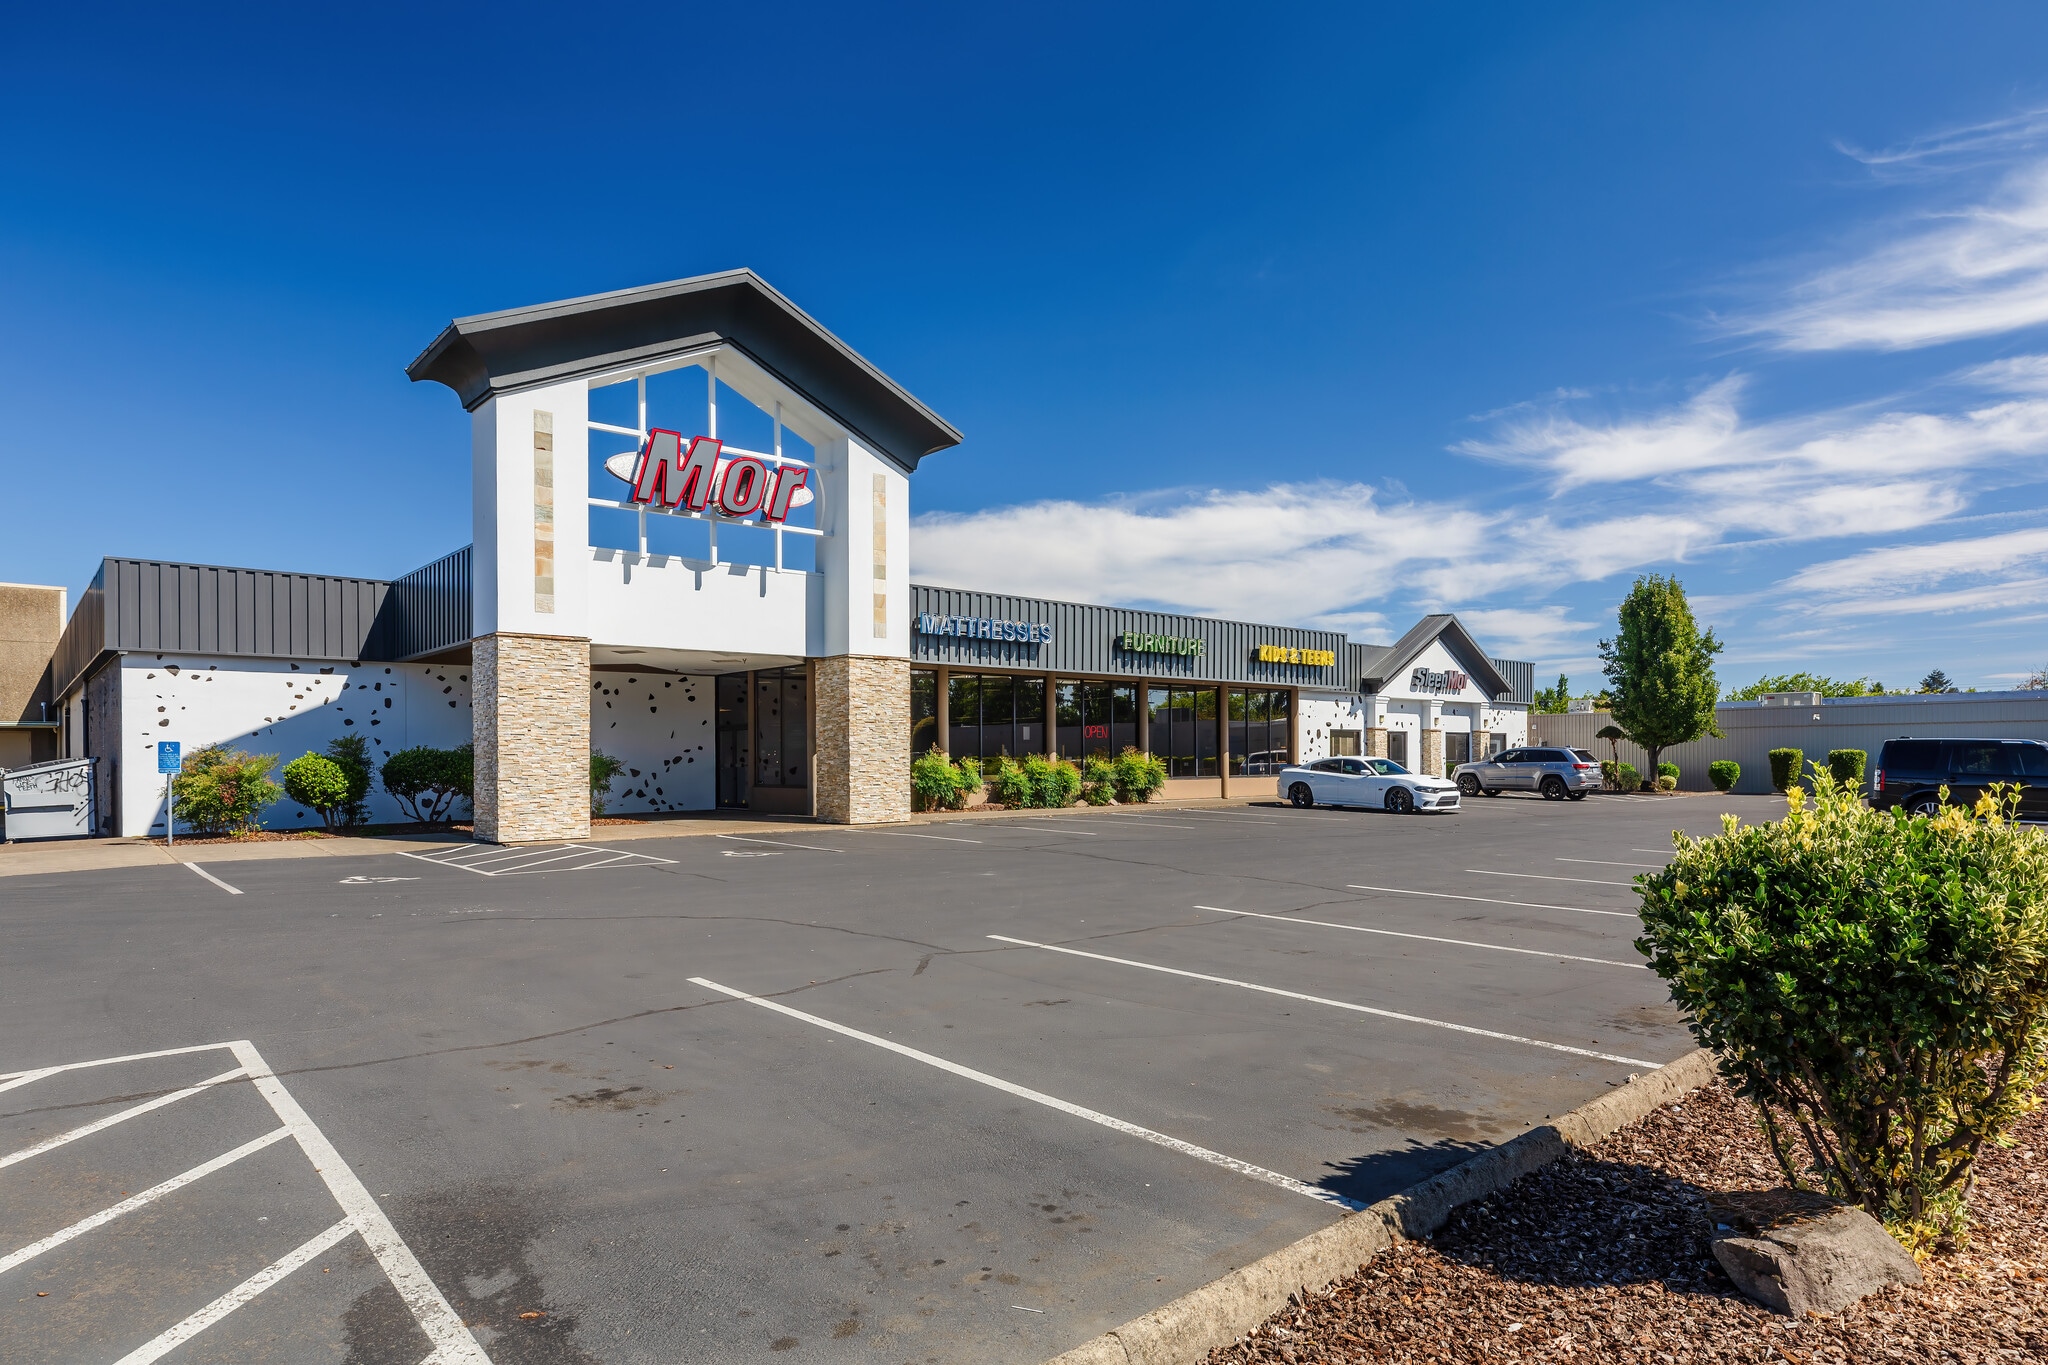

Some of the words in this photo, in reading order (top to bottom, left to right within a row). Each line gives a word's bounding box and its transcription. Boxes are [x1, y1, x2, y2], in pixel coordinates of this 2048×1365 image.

[633, 428, 808, 522] Mor
[920, 611, 1052, 644] MATTRESSES
[1123, 630, 1207, 657] FURNITURE
[1259, 645, 1287, 663] KIDS
[1289, 647, 1299, 664] &
[1301, 648, 1335, 667] TEENS
[1415, 667, 1469, 690] SleepMor
[1084, 725, 1108, 739] OPEN
